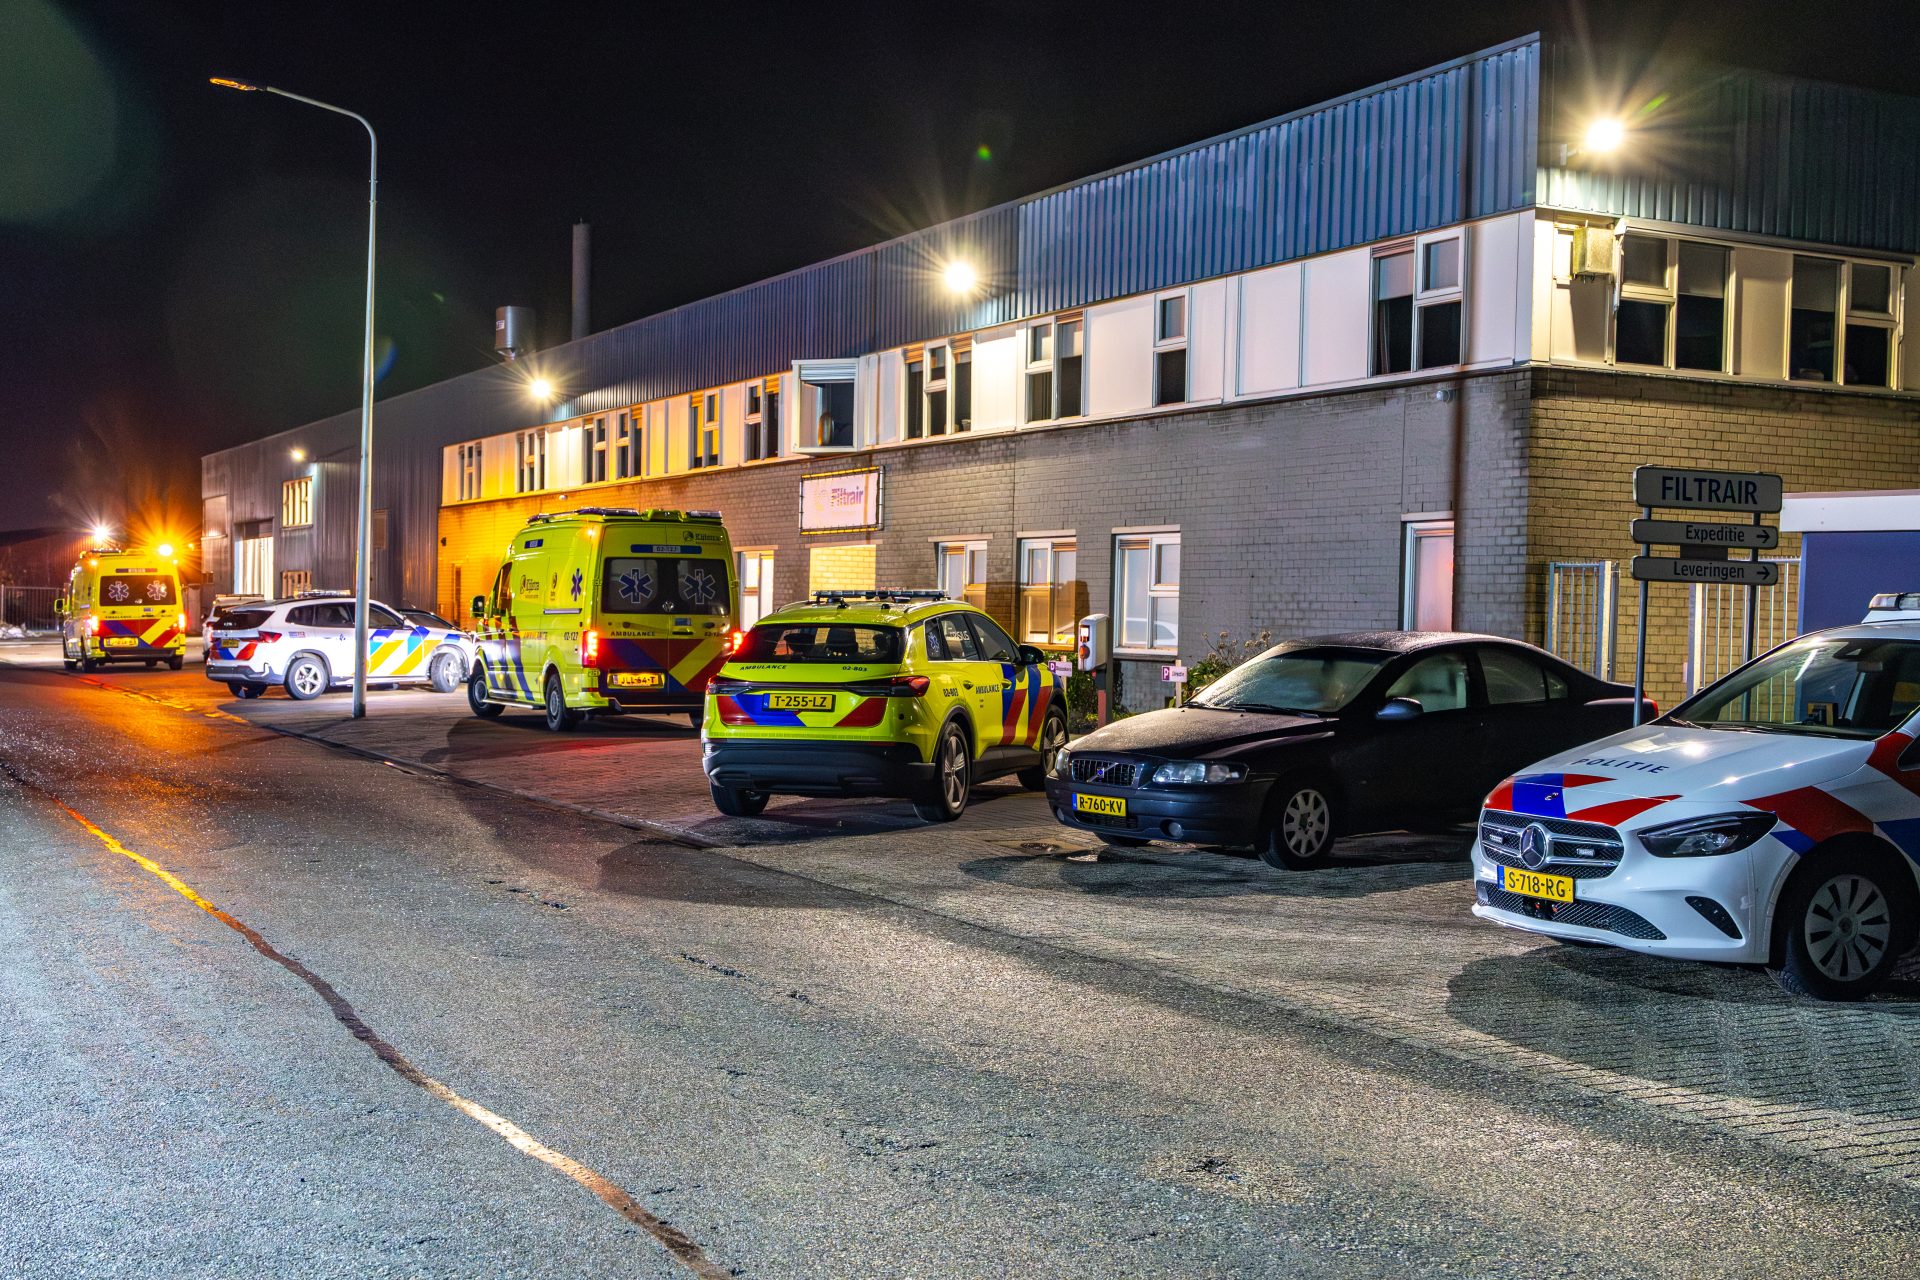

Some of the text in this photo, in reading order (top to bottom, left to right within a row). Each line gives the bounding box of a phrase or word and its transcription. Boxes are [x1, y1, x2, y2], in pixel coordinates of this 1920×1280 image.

[831, 485, 864, 507] Filtrair
[1661, 476, 1758, 505] FILTRAIR
[1686, 525, 1745, 543] Expeditie
[1674, 561, 1745, 578] Leveringen
[975, 683, 1000, 694] AMBULANCE
[774, 695, 827, 708] T-255-LZ
[1571, 758, 1670, 774] POLITIE
[1079, 796, 1123, 814] R-760-KV
[1508, 871, 1566, 898] S-718-RG
